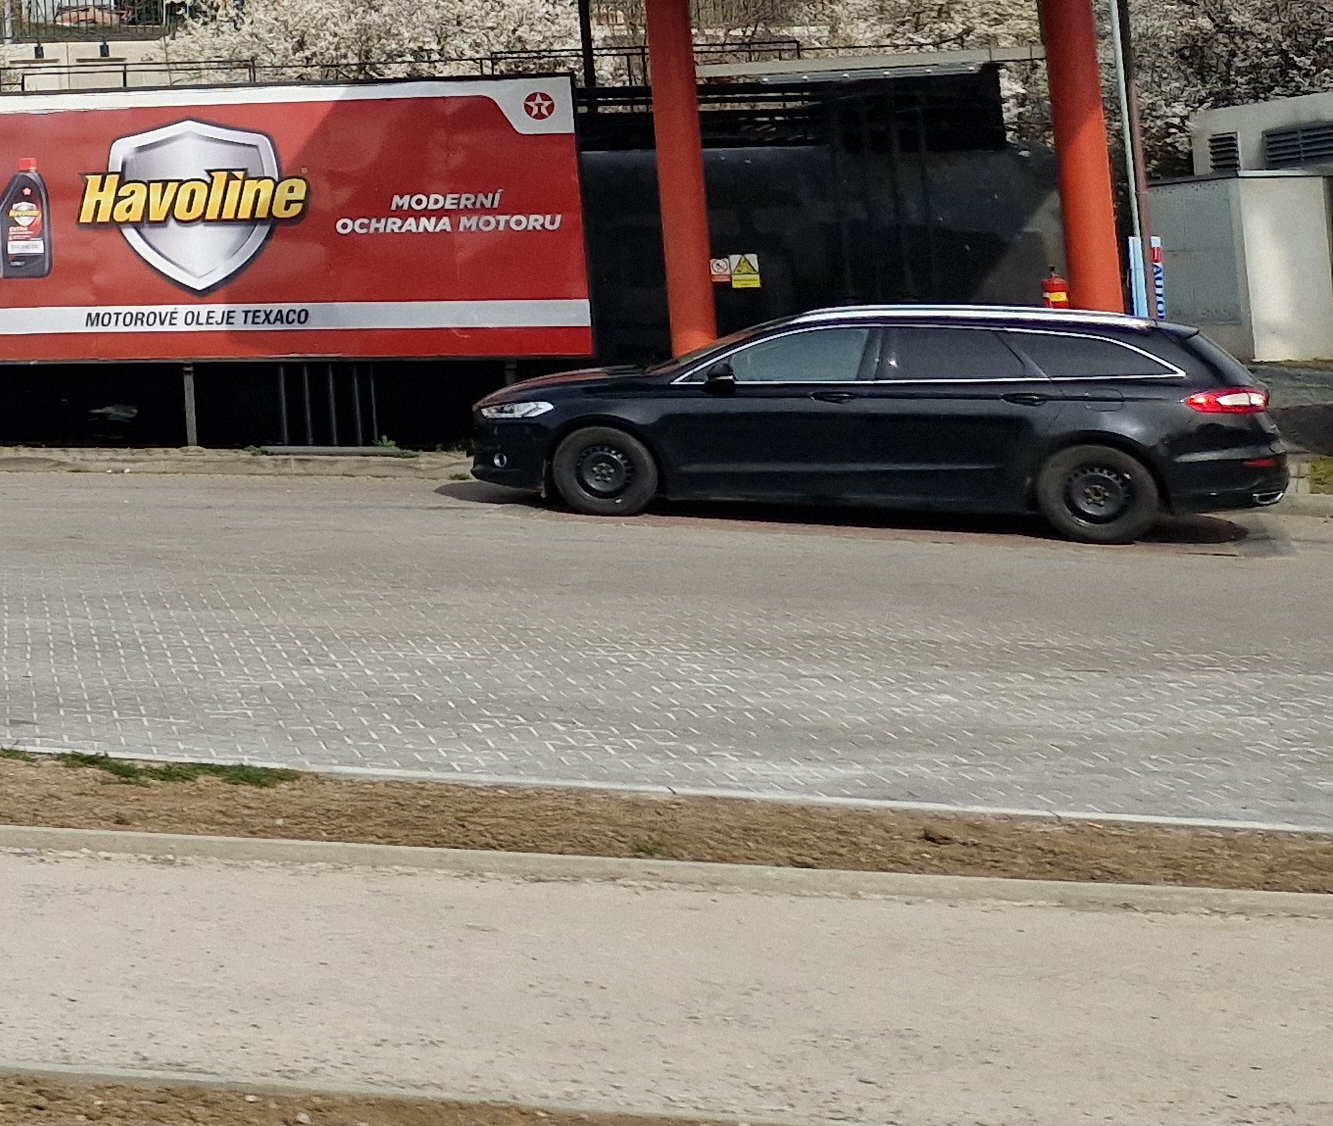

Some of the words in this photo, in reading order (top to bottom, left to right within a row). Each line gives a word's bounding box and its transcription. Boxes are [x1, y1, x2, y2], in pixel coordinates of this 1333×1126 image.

[78, 170, 308, 224] Havoline
[390, 189, 504, 211] MODERNÍ
[335, 216, 452, 235] OCHRANA
[458, 214, 562, 232] MOTORU
[85, 307, 179, 328] MOTOROVÉ
[184, 310, 237, 325] OLEJE
[241, 308, 310, 324] TEXACO
